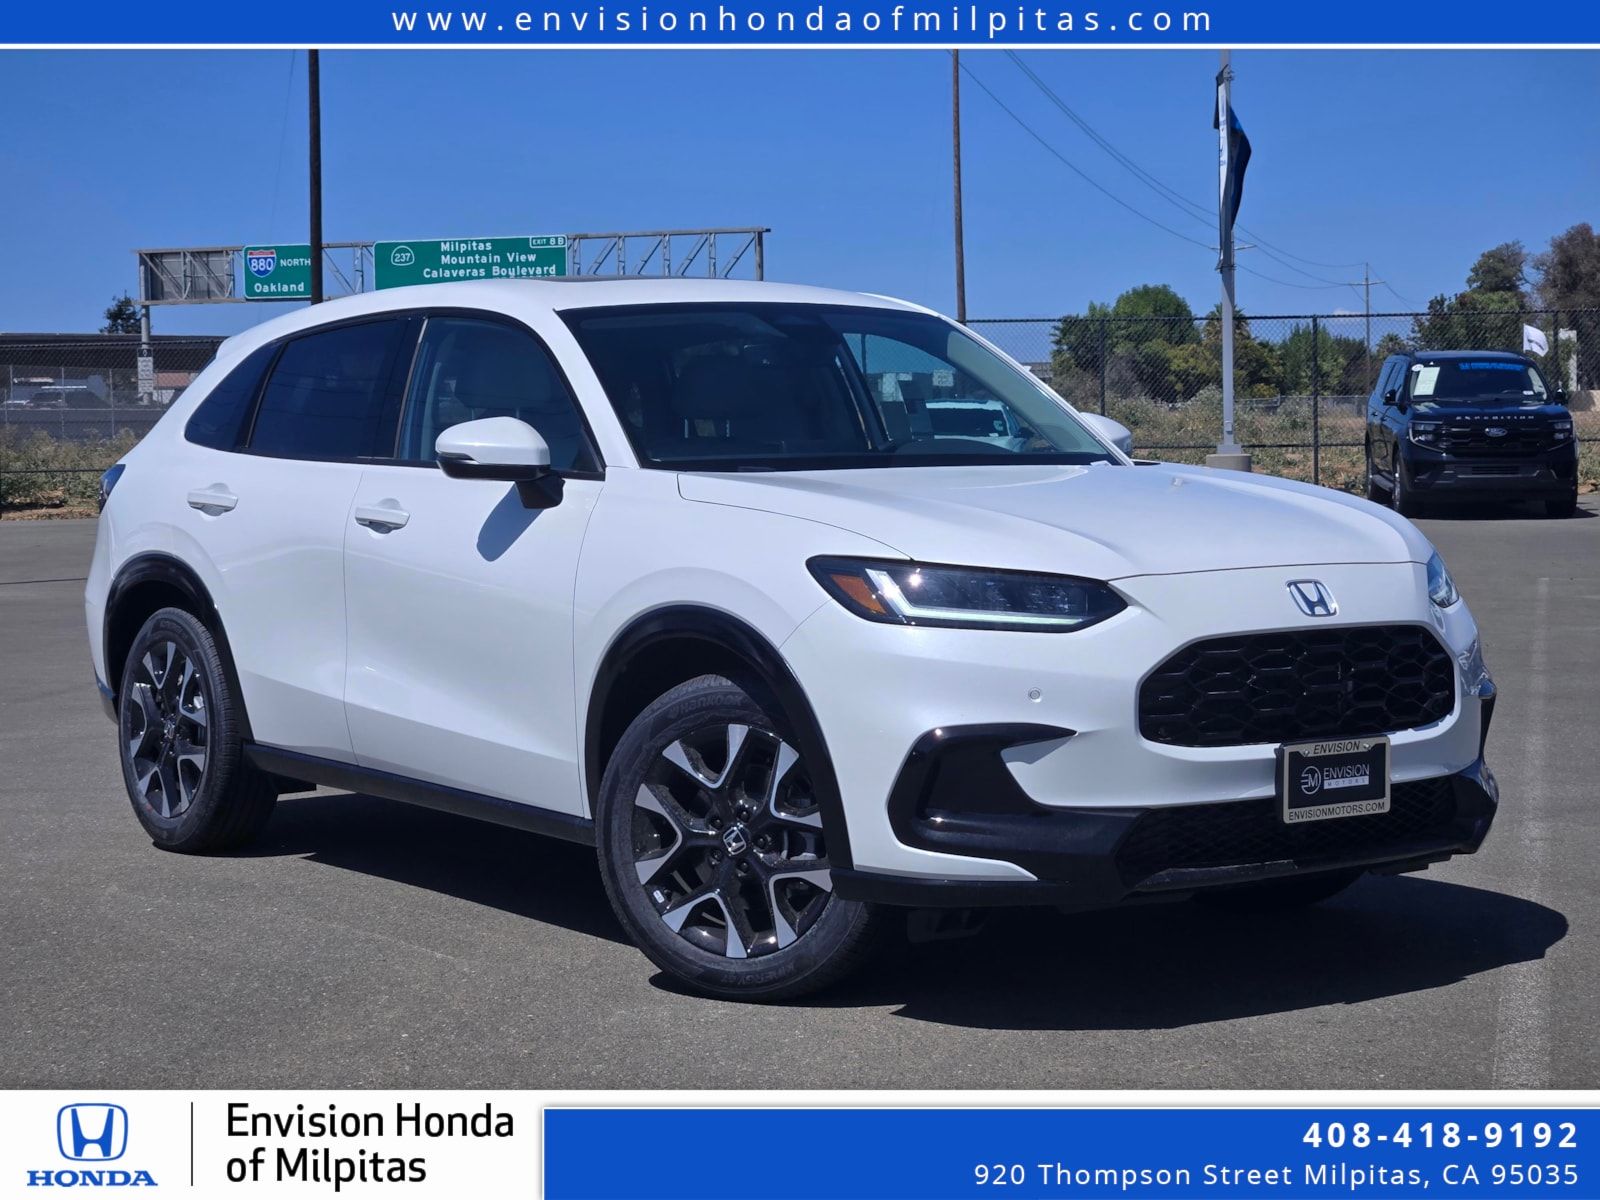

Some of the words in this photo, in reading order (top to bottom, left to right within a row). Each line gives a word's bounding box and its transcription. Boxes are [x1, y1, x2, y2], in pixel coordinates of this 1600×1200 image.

[440, 241, 492, 253] Milpitas
[532, 238, 547, 246] EXIT
[280, 258, 311, 267] NORTH
[394, 253, 411, 262] 237
[441, 253, 500, 265] Mountain
[506, 252, 537, 263] View
[251, 258, 274, 271] 880
[423, 267, 486, 278] Calaveras
[492, 264, 556, 277] Boulevard
[254, 282, 304, 292] Oakland
[1313, 740, 1361, 755] ENVISION
[1323, 763, 1370, 780] ENVISION
[1288, 801, 1385, 821] ENVISIONMOTORS.COM
